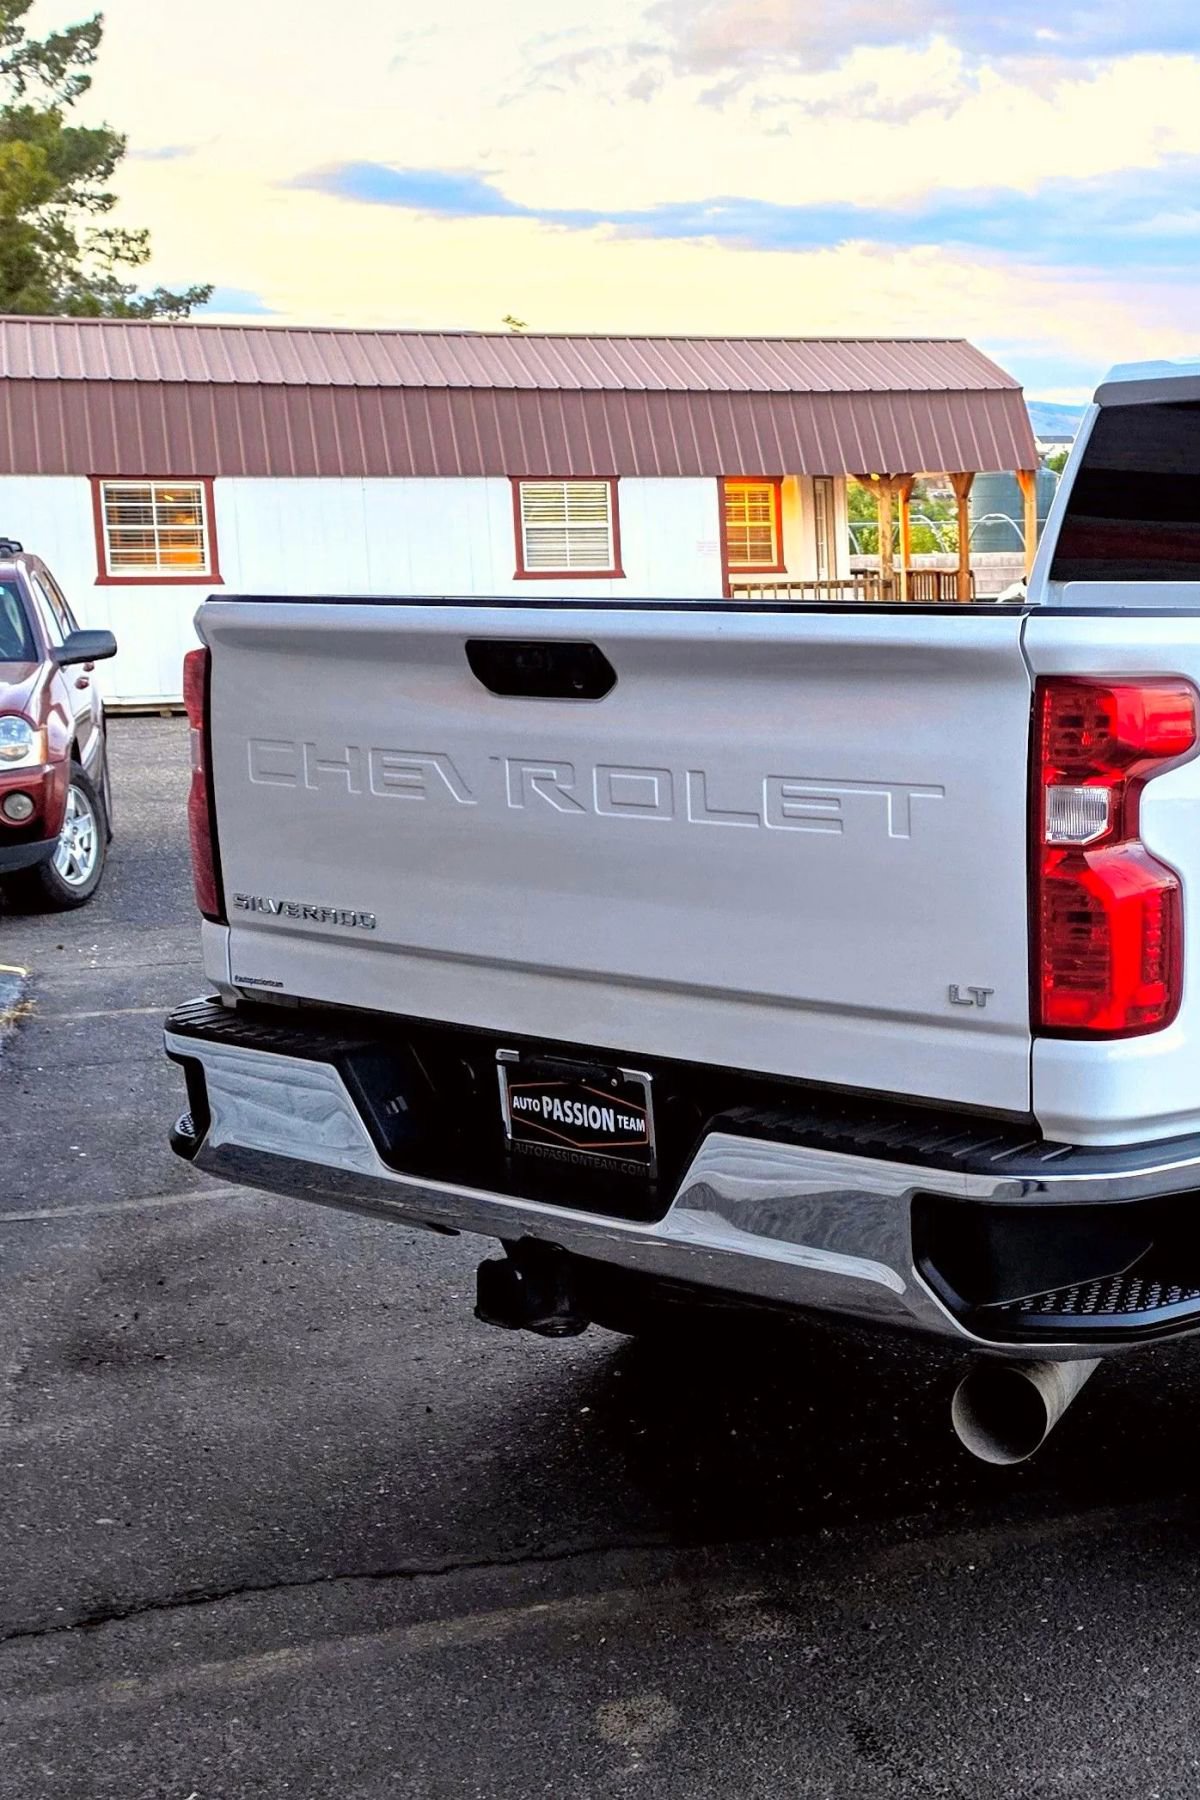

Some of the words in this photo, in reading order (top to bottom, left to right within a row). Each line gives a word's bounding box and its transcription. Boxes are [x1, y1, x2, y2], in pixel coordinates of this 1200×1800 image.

[247, 738, 946, 839] CHEVROLET
[233, 893, 377, 930] SILVERADO
[948, 984, 995, 1007] LT
[512, 1095, 541, 1112] AUTO
[541, 1095, 616, 1133] PASSION
[616, 1114, 646, 1132] TEAM
